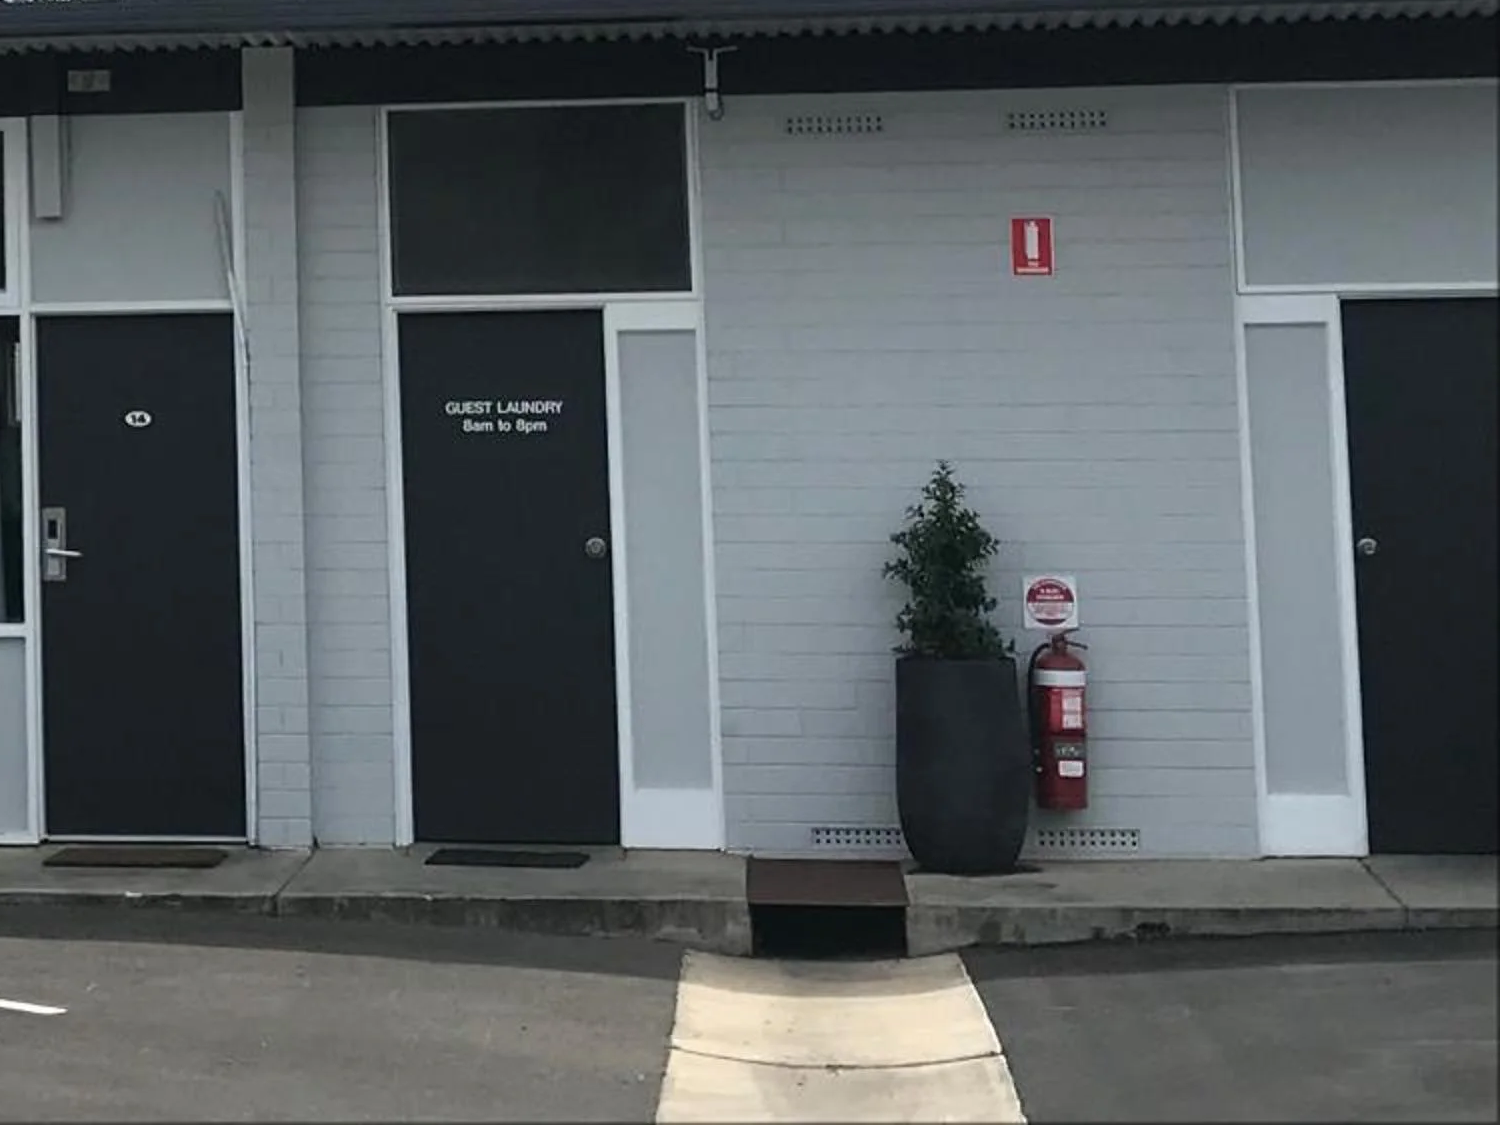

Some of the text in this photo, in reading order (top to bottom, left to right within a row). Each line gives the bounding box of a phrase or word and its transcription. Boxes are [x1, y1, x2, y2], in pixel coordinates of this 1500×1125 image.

[445, 400, 564, 415] GUEST LAUNDRY
[462, 418, 548, 434] 8am to 8pm
